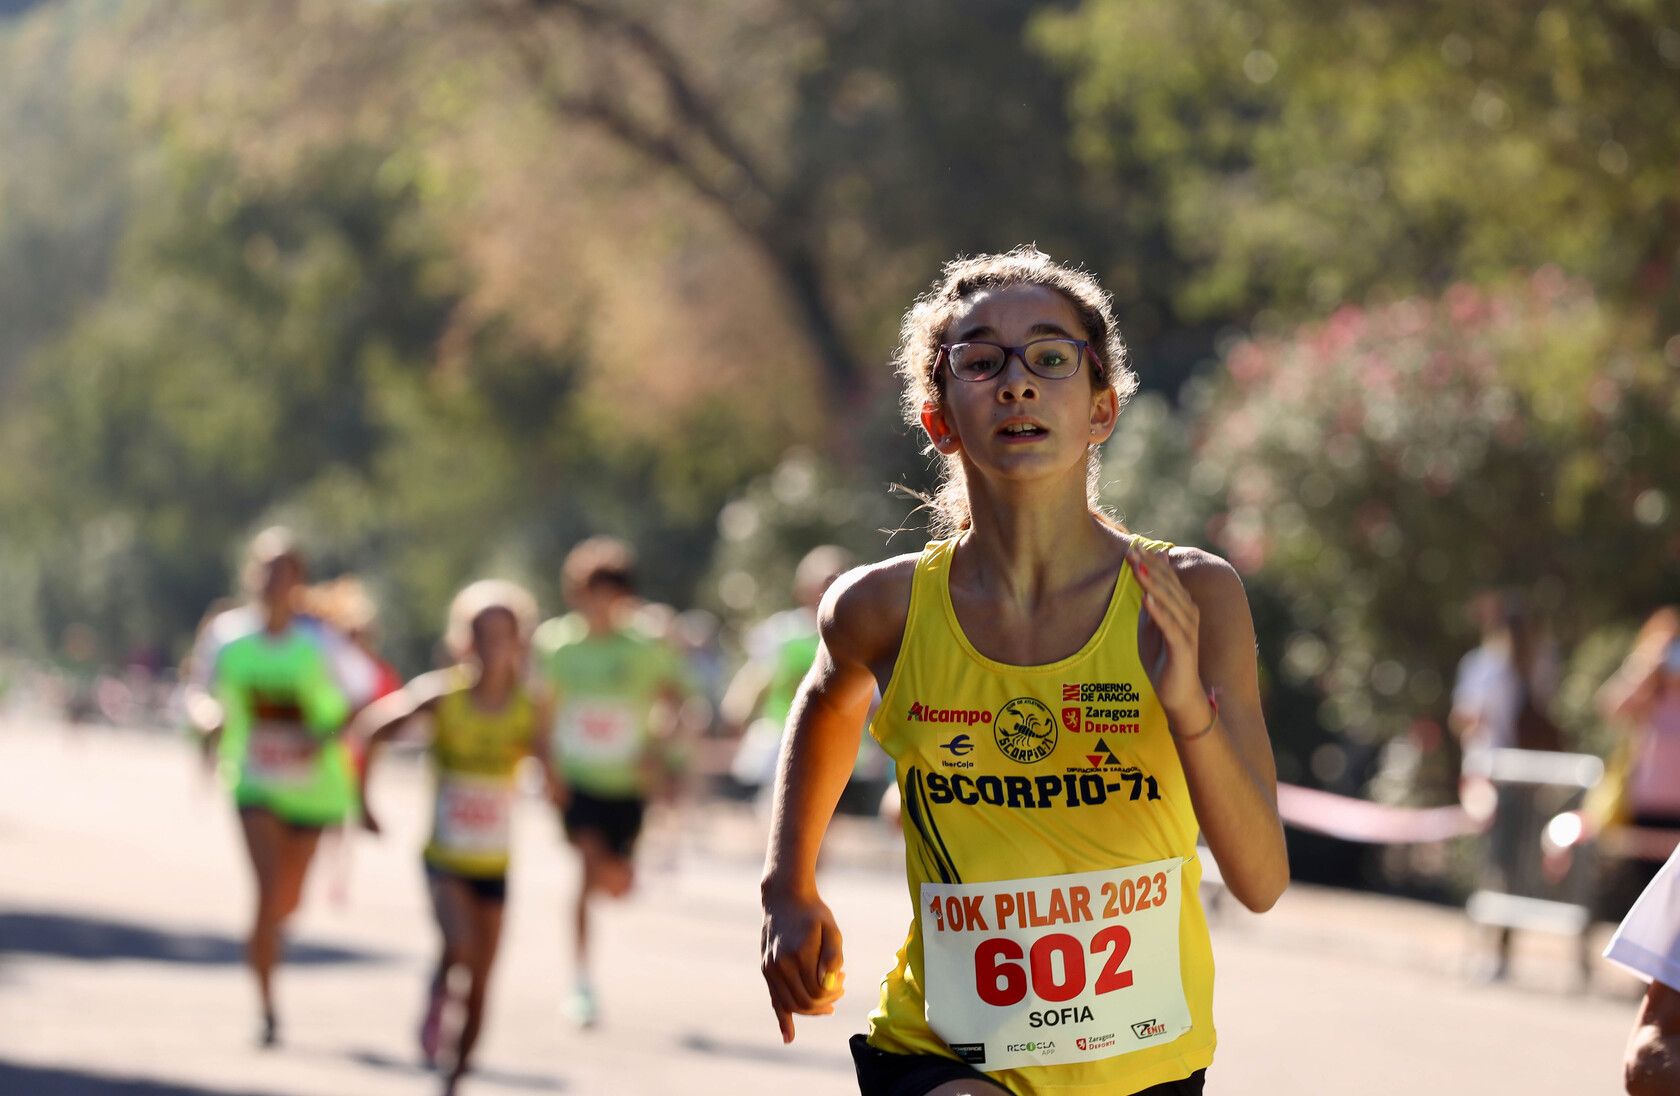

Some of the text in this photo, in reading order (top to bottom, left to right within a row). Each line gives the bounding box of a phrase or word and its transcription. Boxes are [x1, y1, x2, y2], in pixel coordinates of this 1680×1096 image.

[1081, 683, 1132, 692] GOBIERNO
[1081, 693, 1139, 702] DE ARAGON
[907, 701, 992, 726] Alcampo
[1086, 706, 1139, 721] Zaragoza
[1085, 721, 1139, 733] DEPORTE
[926, 772, 1161, 808] SCORPIO-71
[930, 872, 1167, 932] 10K PILAR 2023
[974, 925, 1133, 1007] 602
[1029, 1005, 1094, 1028] SOFIA
[1088, 1033, 1115, 1043] Zaragoza
